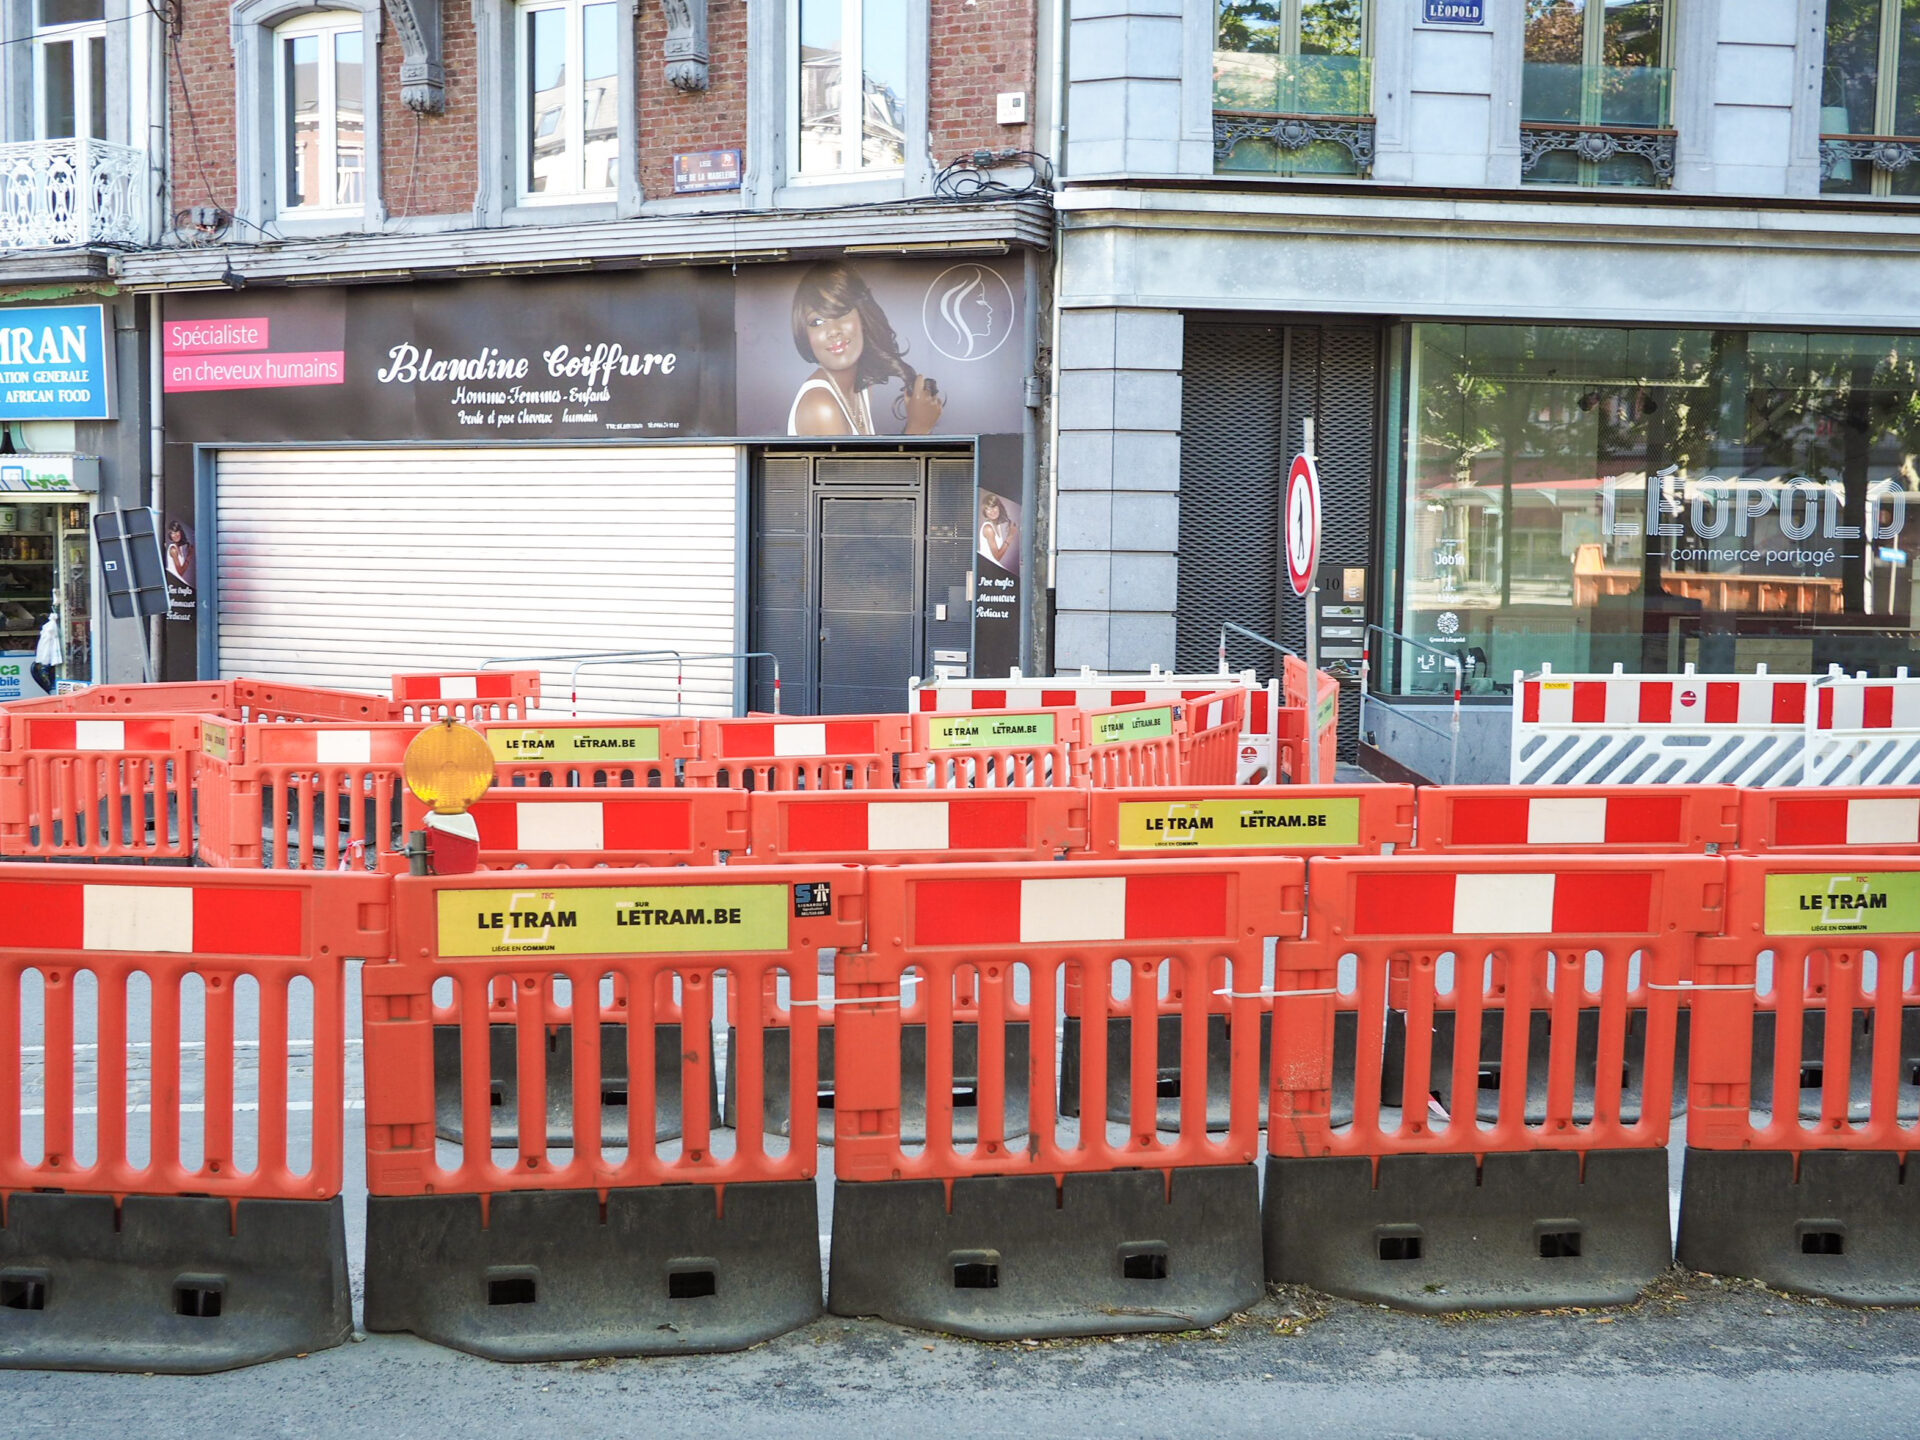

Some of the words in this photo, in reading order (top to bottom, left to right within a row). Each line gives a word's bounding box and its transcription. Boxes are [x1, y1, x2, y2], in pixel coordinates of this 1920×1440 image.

[1430, 1, 1479, 18] LÉOPOLD
[172, 324, 259, 350] Spécialiste
[172, 366, 192, 382] en
[195, 360, 263, 381] cheveux
[266, 357, 338, 380] humains
[377, 341, 529, 384] Blandine
[542, 342, 677, 386] Coiffure
[33, 370, 90, 383] GENERALE
[5, 389, 54, 403] AFRICAN
[58, 388, 91, 402] FOOD
[562, 407, 598, 423] humain
[1602, 463, 1906, 541] LÉOPOLD
[1670, 548, 1760, 562] commerce
[1766, 547, 1835, 566] partagé
[1325, 578, 1340, 591] 10
[0, 664, 19, 676] ca
[0, 676, 20, 686] bile
[944, 728, 953, 736] LE
[955, 727, 979, 736] TRAM
[992, 725, 1037, 735] LETRAM.BE
[1108, 722, 1124, 731] TRAM
[506, 740, 519, 749] LE
[522, 739, 555, 748] TRAM
[574, 739, 636, 748] LETRAM.BE
[1146, 818, 1164, 830] LE
[1168, 817, 1214, 829] TRAM
[1240, 815, 1327, 828] LETRAM.BE
[1800, 895, 1822, 910] LE
[1827, 893, 1887, 909] TRAM
[478, 912, 504, 929] LE
[509, 911, 577, 928] TRAM
[617, 908, 741, 926] LETRAM.BE
